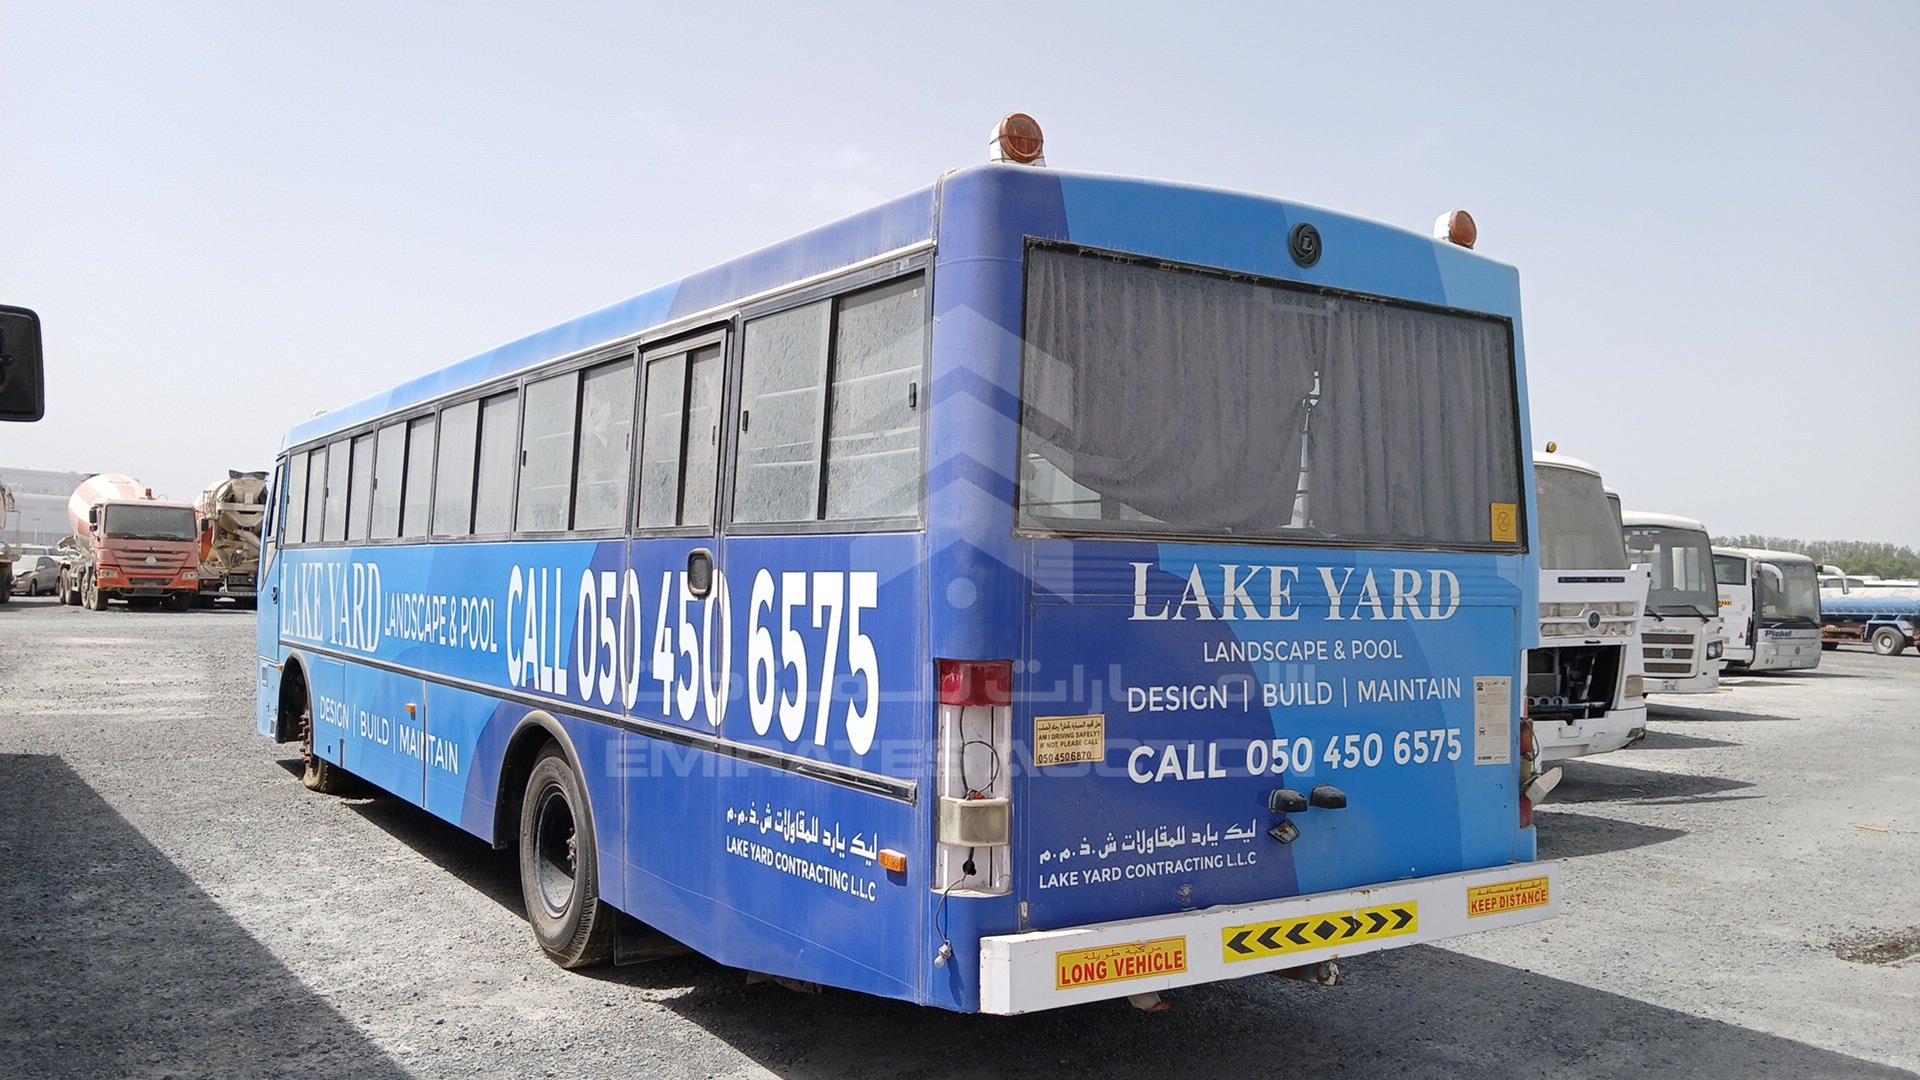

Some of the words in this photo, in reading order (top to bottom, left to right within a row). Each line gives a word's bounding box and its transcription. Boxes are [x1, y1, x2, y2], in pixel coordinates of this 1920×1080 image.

[281, 562, 324, 642] LAKE
[327, 562, 381, 653] YARD
[1128, 561, 1301, 622] LAKE
[1316, 565, 1461, 622] YARD
[385, 592, 447, 645] LANDSCAPE
[449, 597, 457, 648] &
[461, 597, 498, 653] POOL
[506, 564, 568, 696] CALL
[577, 568, 641, 710] 050
[652, 568, 731, 727] 450
[747, 568, 879, 756] 6575
[1203, 640, 1327, 663] LANDSCAPE
[1333, 641, 1346, 660] &
[1352, 639, 1403, 660] POOL
[1128, 684, 1228, 713] DESIGN
[1263, 681, 1333, 708] BUILD
[1358, 676, 1461, 704] MAINTAIN
[320, 696, 349, 730] DESIGN
[360, 711, 389, 746] BUILD
[399, 724, 458, 775] MAINTAIN
[1038, 733, 1048, 741] AM
[1051, 732, 1075, 740] DRIVING
[1075, 730, 1101, 739] SAFELY?
[1060, 740, 1082, 748] PLEASE
[1127, 742, 1227, 784] CALL
[1246, 737, 1313, 776] 050
[1323, 733, 1383, 770] 450
[1393, 728, 1462, 765] 6575
[775, 808, 819, 844] للمقاولات
[822, 822, 846, 858] يارد
[1121, 825, 1186, 854] للمقاولات
[1191, 822, 1219, 847] يارد
[1224, 818, 1257, 841] ليك
[850, 833, 878, 866] ليك
[726, 836, 749, 858] LAKE
[750, 842, 774, 866] YARD
[775, 851, 848, 892] CONTRACTING
[850, 874, 876, 902] L.L.C
[1039, 872, 1079, 889] LAKE
[1083, 867, 1122, 884] YARD
[1126, 854, 1224, 879] CONTRACTING
[1226, 852, 1257, 867] L.L.C
[1471, 897, 1497, 913] KEEP
[1499, 889, 1547, 908] DISTANCE
[1062, 961, 1107, 985] LONG
[1114, 950, 1183, 977] VEHICLE
